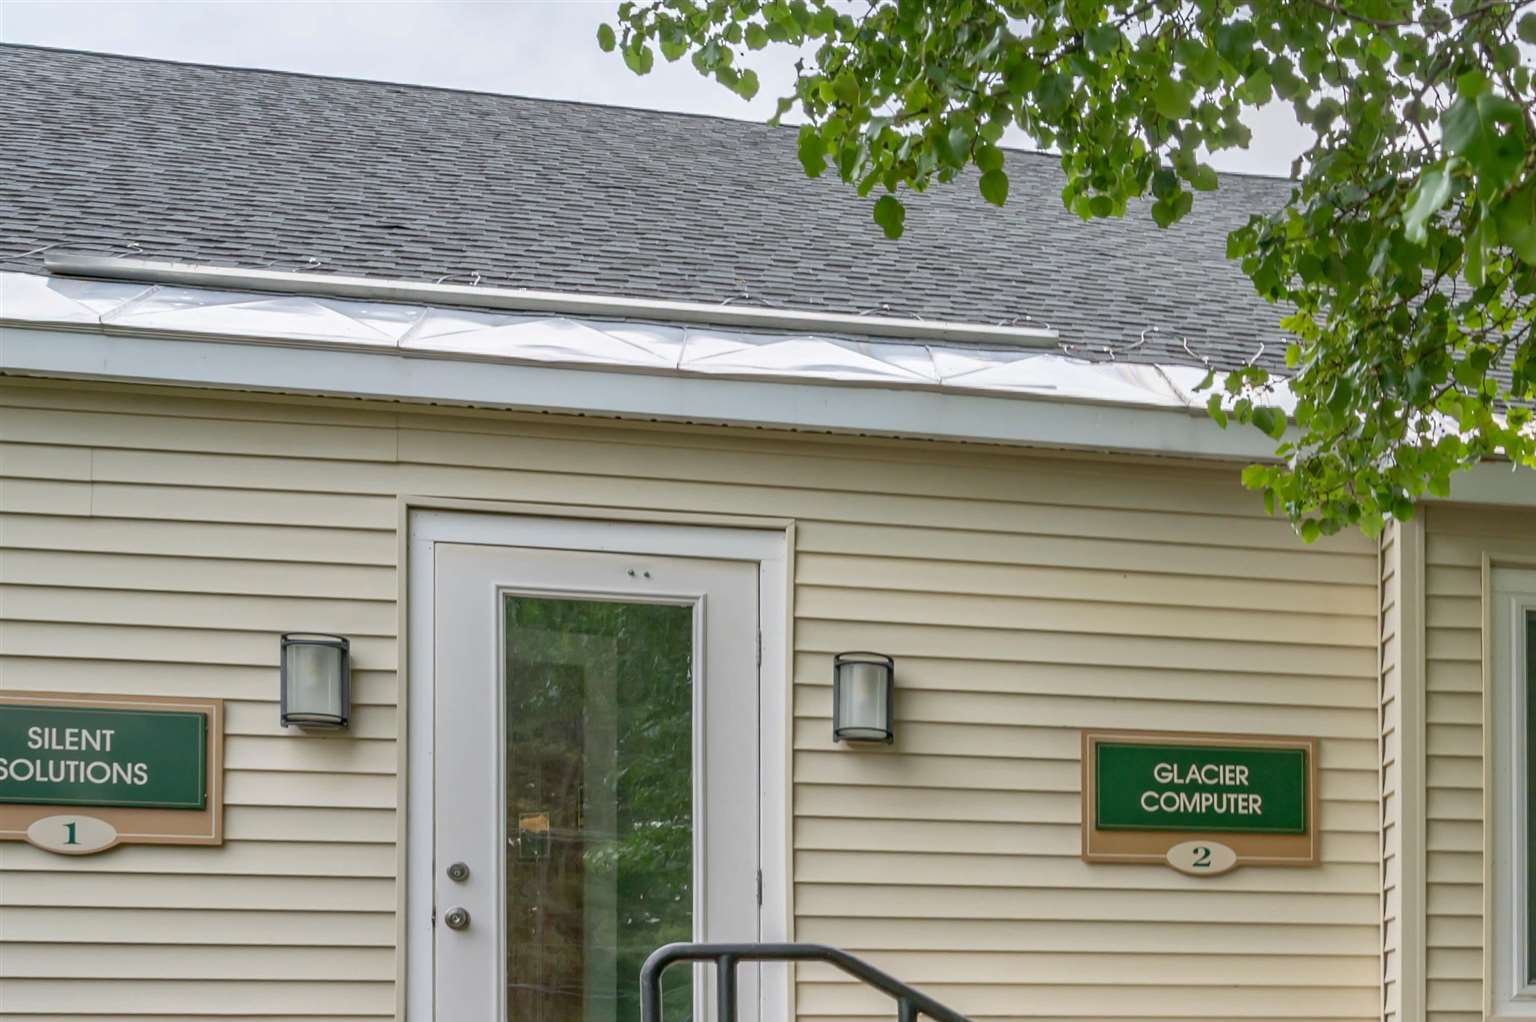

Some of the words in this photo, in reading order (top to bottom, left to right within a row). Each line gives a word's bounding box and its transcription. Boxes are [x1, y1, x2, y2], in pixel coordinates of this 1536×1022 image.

[27, 726, 115, 752] SILENT
[0, 757, 149, 785] SOLUTIONS
[1153, 762, 1249, 786] GLACIER
[1140, 790, 1263, 815] COMPUTER
[62, 821, 81, 845] 1
[1192, 846, 1212, 868] 2
